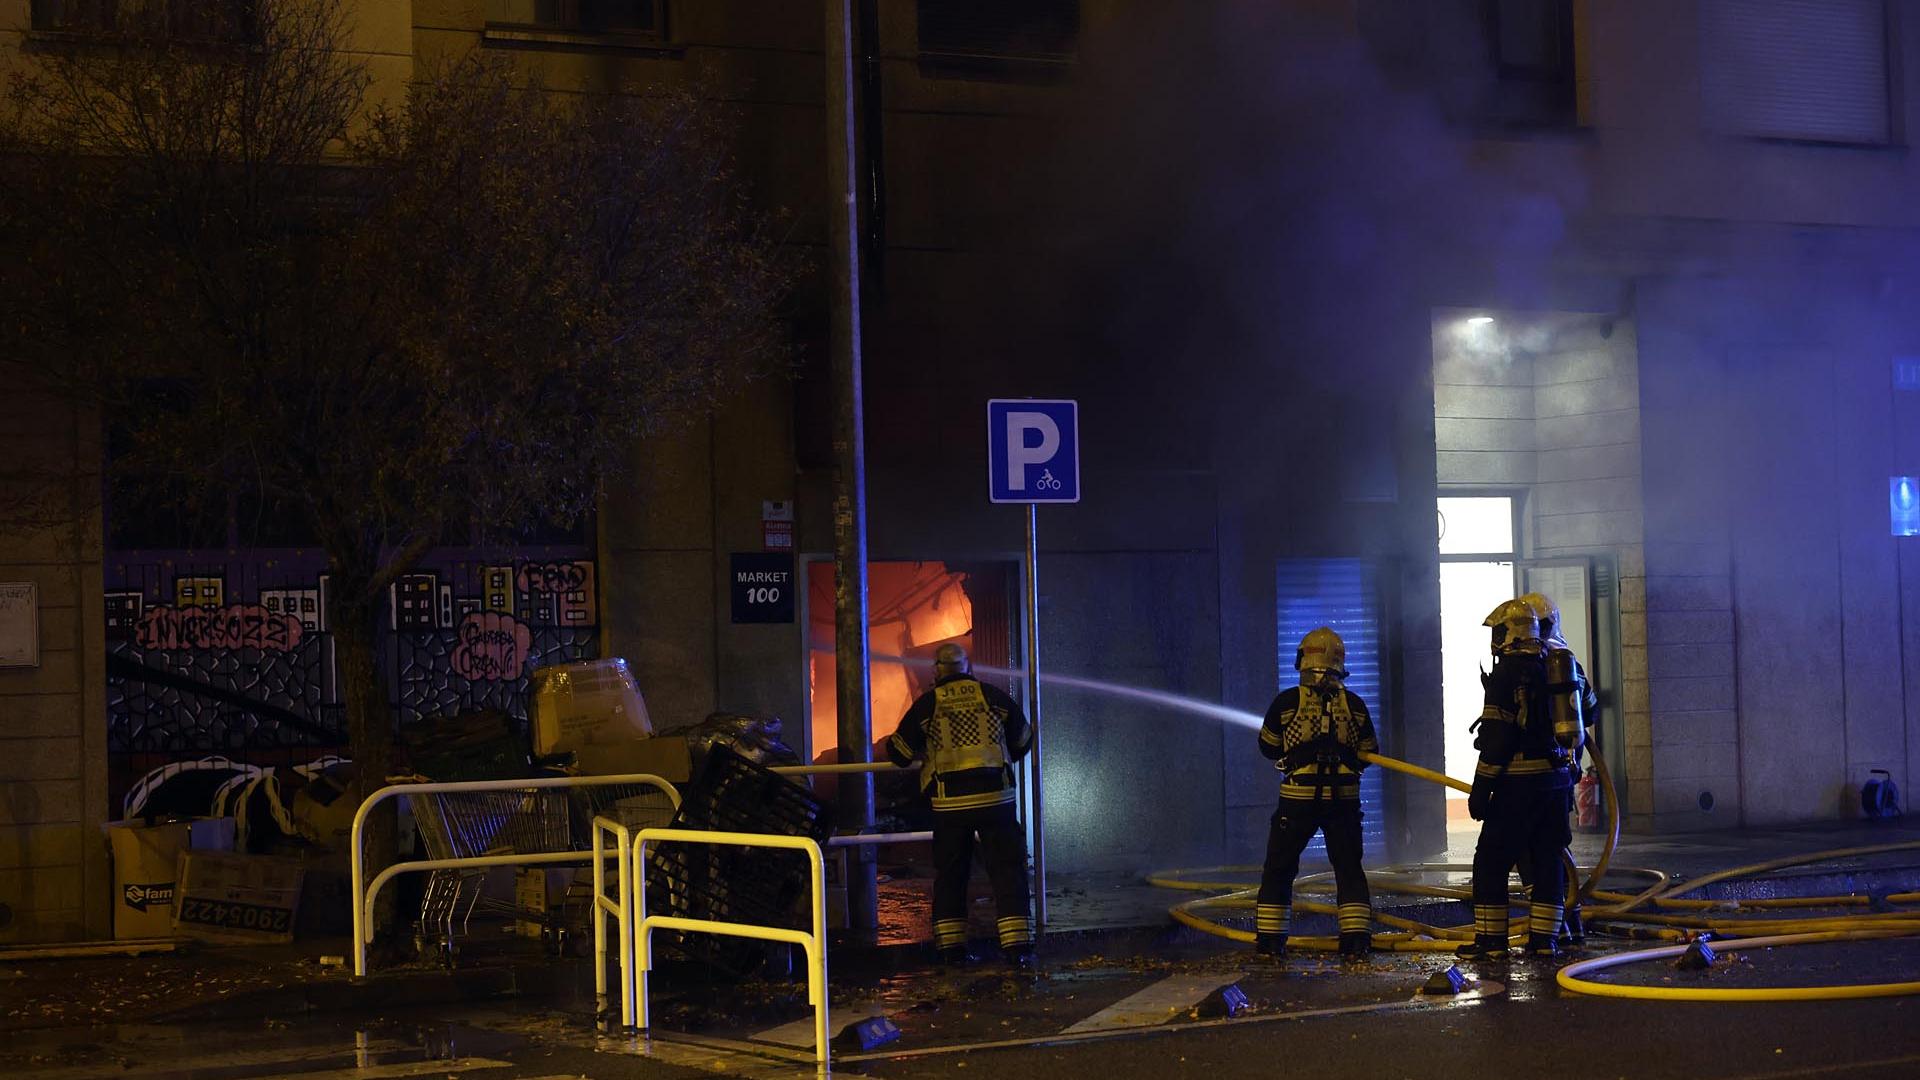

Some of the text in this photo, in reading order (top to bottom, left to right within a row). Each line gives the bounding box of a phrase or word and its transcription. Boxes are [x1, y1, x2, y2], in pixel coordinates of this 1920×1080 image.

[1006, 411, 1060, 491] P
[737, 572, 788, 583] MARKET
[747, 587, 780, 604] 100
